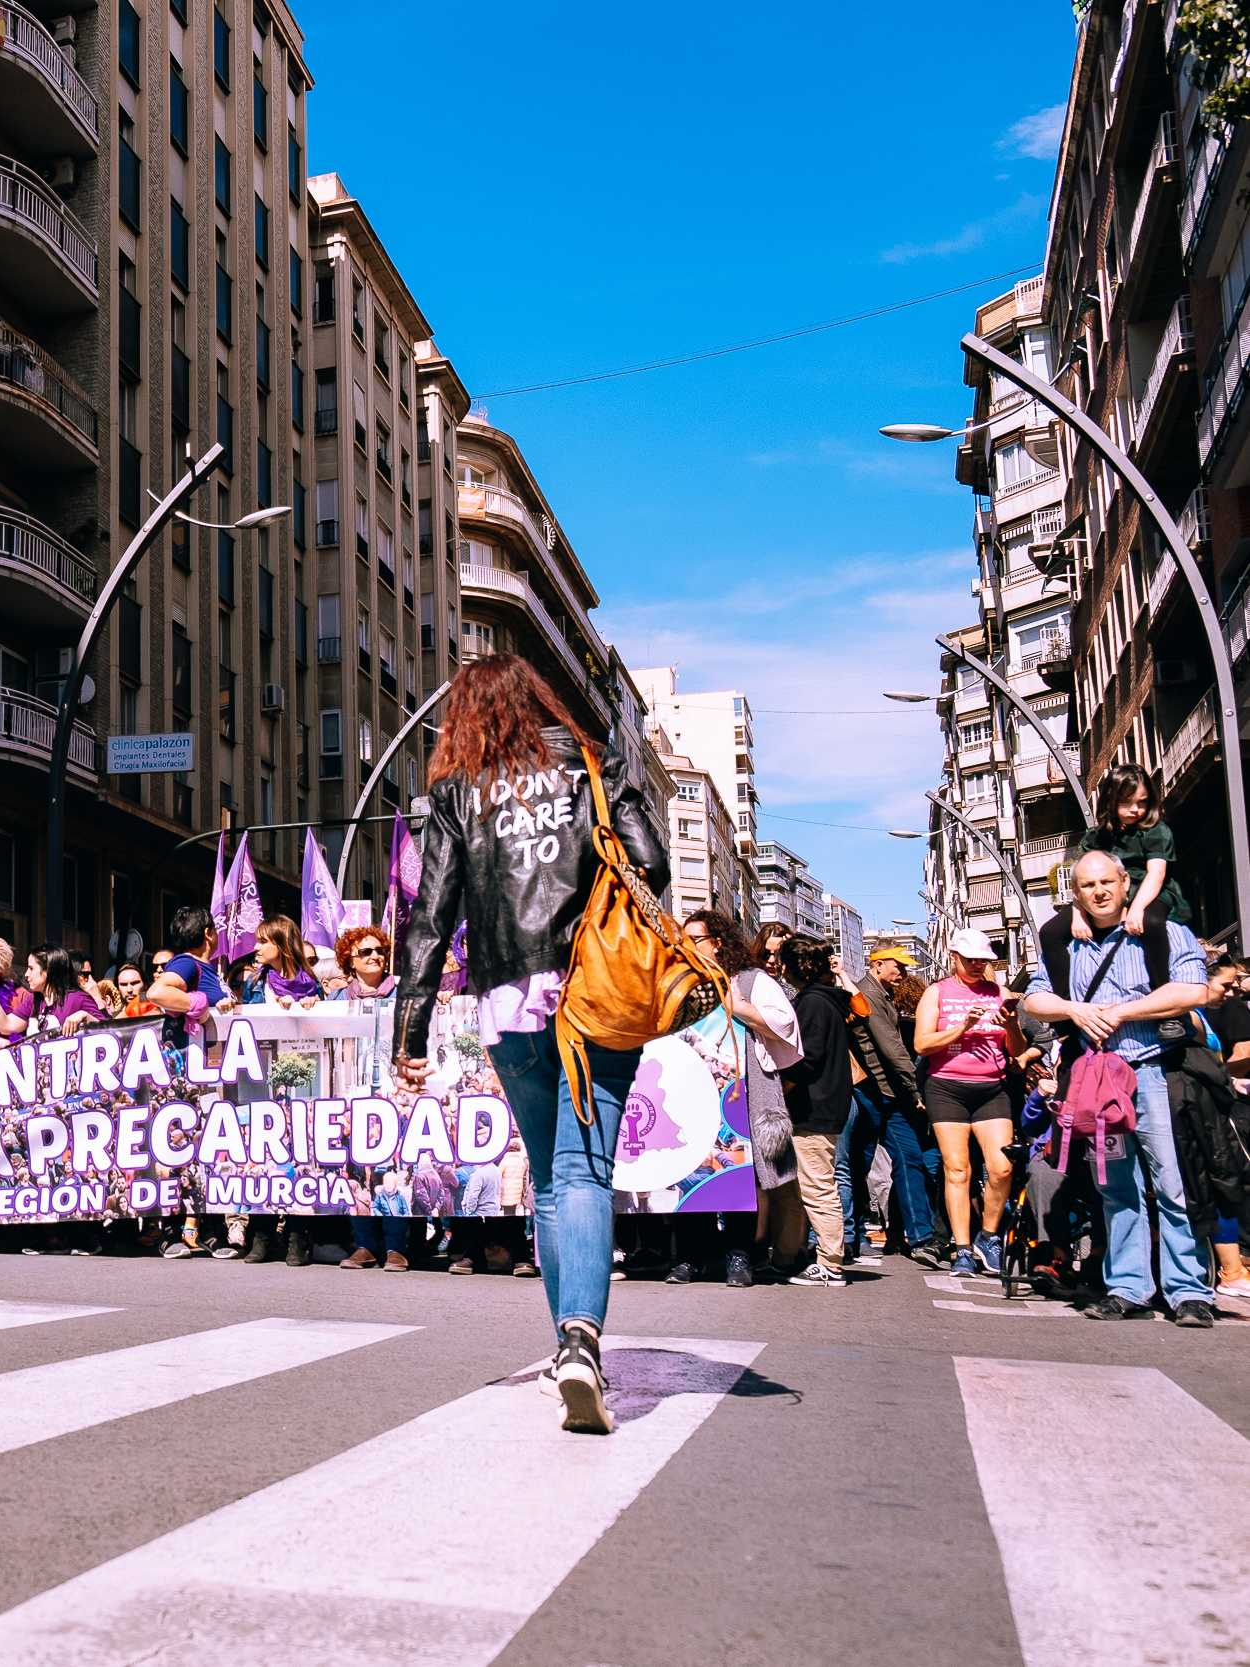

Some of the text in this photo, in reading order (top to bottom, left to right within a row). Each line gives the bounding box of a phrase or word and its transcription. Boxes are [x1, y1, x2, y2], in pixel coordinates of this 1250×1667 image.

[114, 750, 186, 761] Implantes Dentales
[114, 759, 187, 770] Cirugía Maxilofacial
[490, 764, 588, 805] DON'T
[495, 797, 574, 838] CARE
[514, 835, 561, 870] TO
[184, 1018, 265, 1085] LA
[24, 1092, 512, 1177] PRECARIEDAD
[132, 1177, 181, 1211] DE
[207, 1174, 356, 1208] MURCIA
